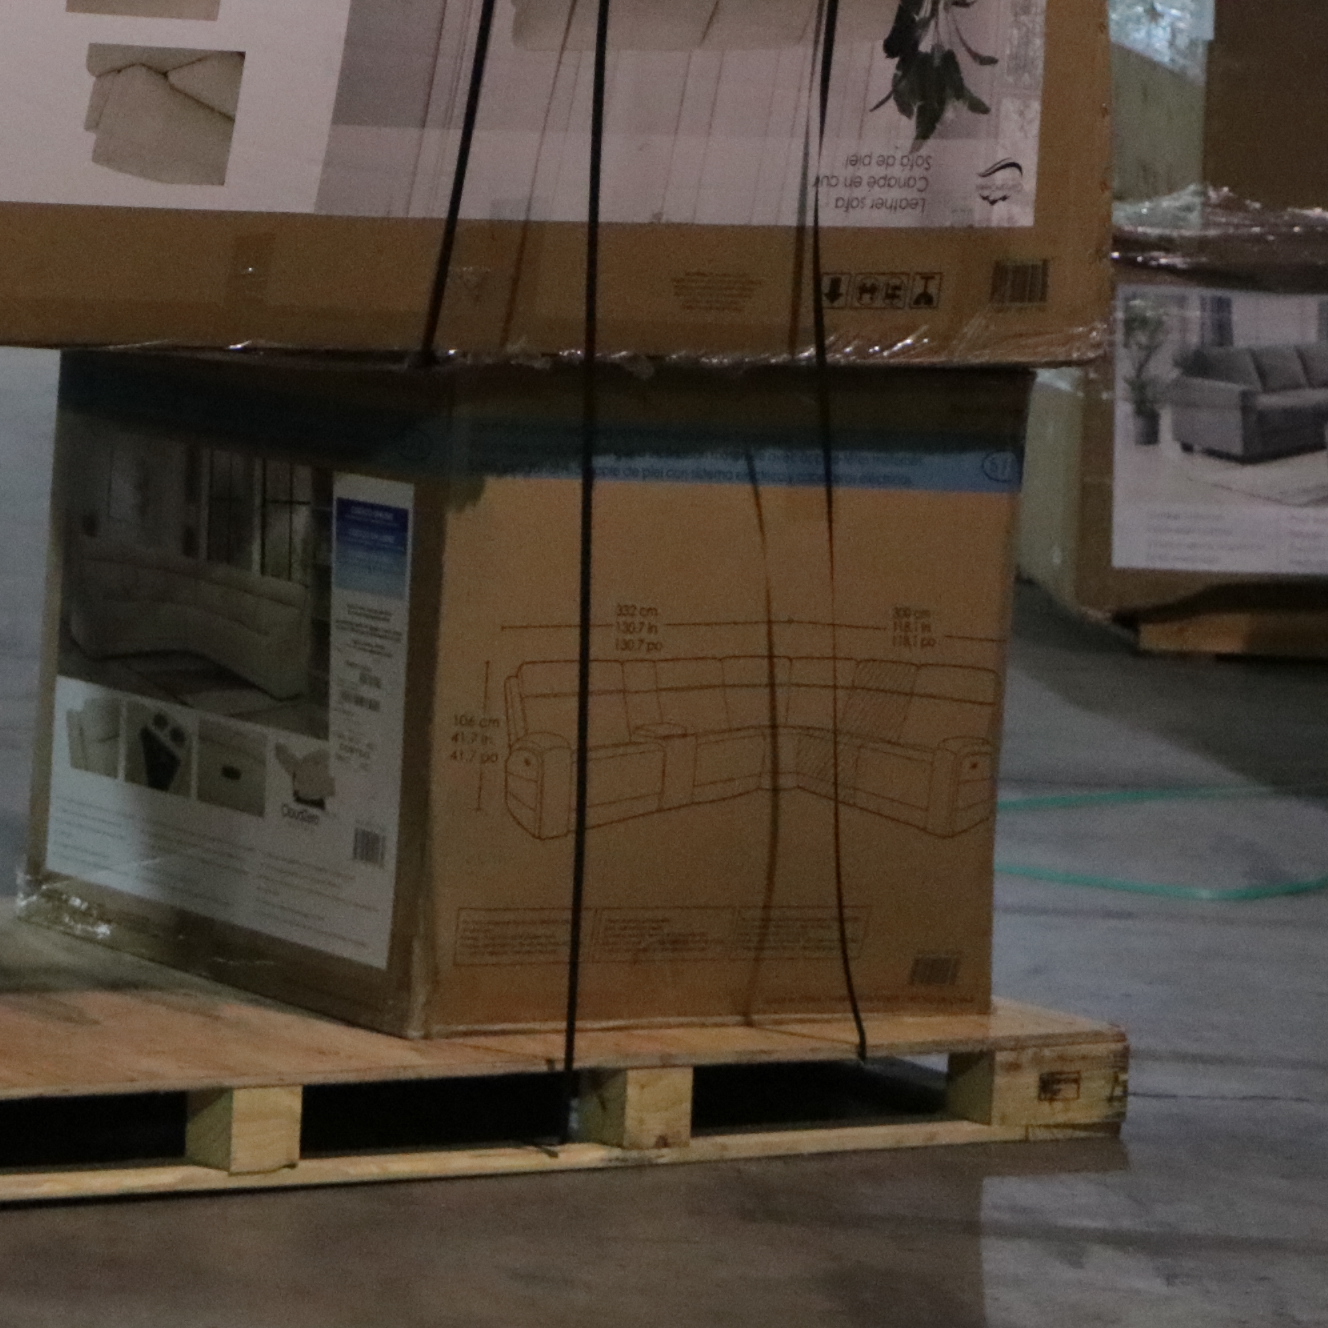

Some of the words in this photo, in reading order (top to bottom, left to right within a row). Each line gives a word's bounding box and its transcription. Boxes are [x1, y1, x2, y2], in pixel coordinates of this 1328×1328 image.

[844, 153, 871, 169] piel
[875, 155, 895, 169] de
[901, 154, 932, 170] Sofá
[843, 175, 863, 187] en
[868, 174, 929, 192] Canapé
[835, 196, 866, 211] sofa
[870, 196, 925, 213] Leather
